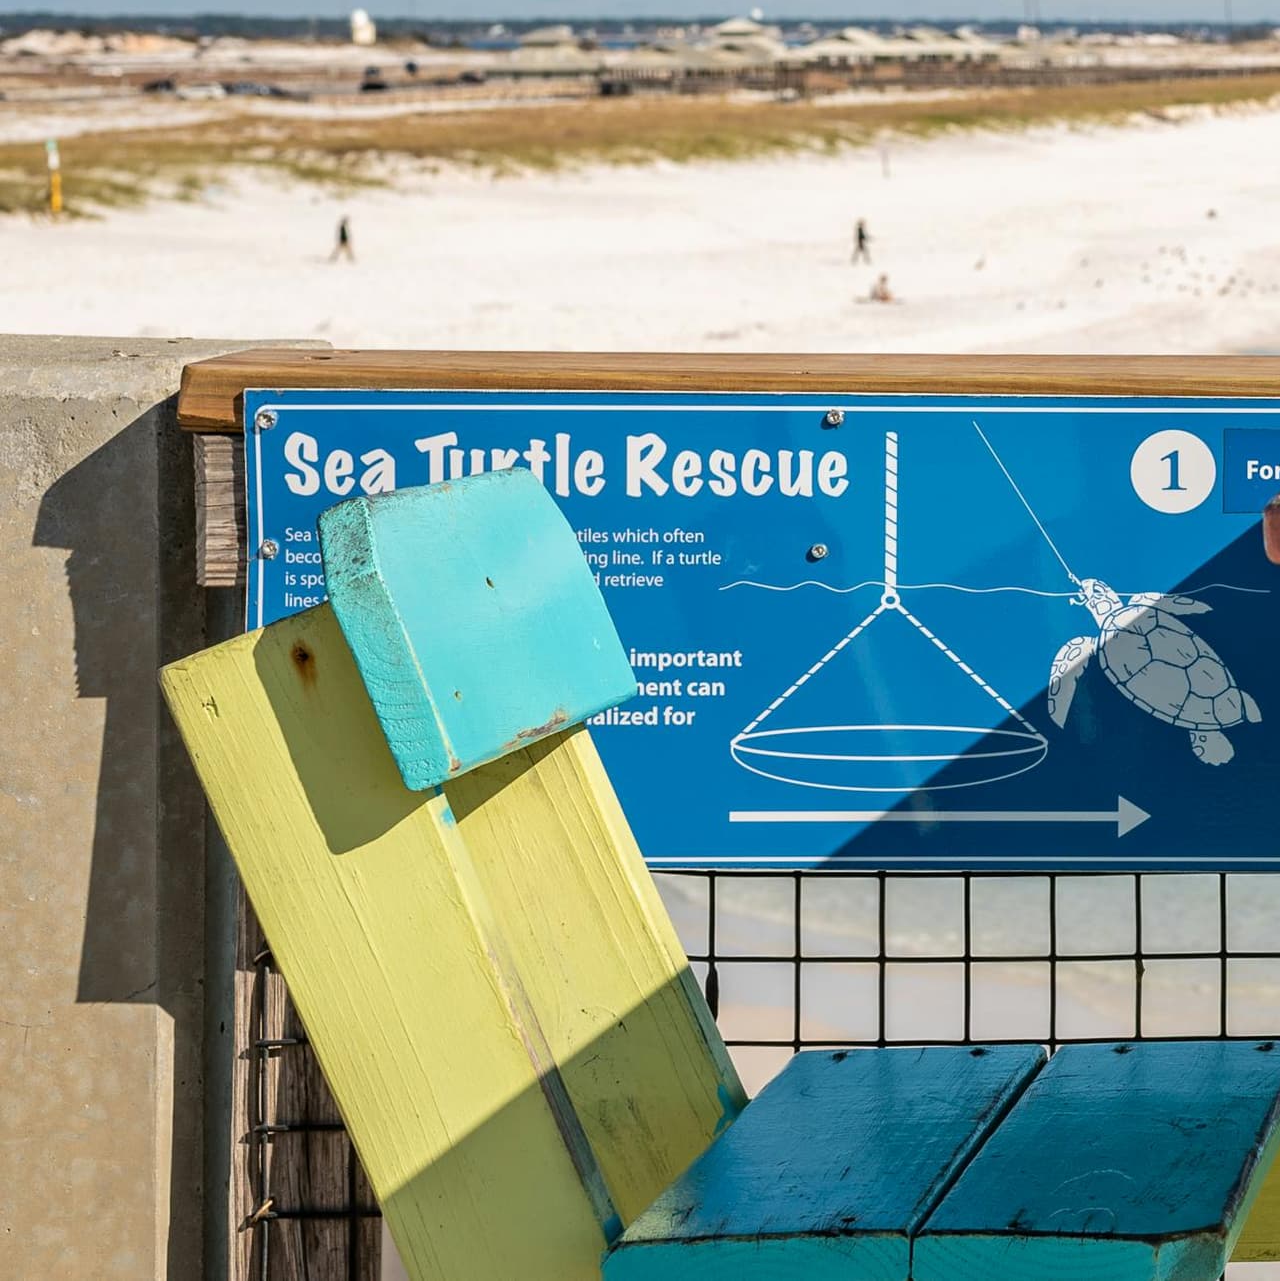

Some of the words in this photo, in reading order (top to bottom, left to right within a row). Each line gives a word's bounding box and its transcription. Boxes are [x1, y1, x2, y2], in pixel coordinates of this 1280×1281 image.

[284, 431, 396, 496] Sea
[624, 432, 850, 497] Rescue
[1160, 450, 1187, 491] 1
[284, 527, 312, 542] Sea
[612, 527, 659, 543] which
[663, 527, 705, 543] often
[612, 549, 644, 565] line.
[651, 549, 664, 565] If
[666, 553, 675, 565] a
[678, 549, 722, 565] turtle
[285, 571, 297, 586] is
[604, 572, 664, 587] retrieve
[284, 592, 320, 609] lines
[630, 647, 743, 672] important
[686, 681, 726, 697] can
[663, 705, 696, 726] for
